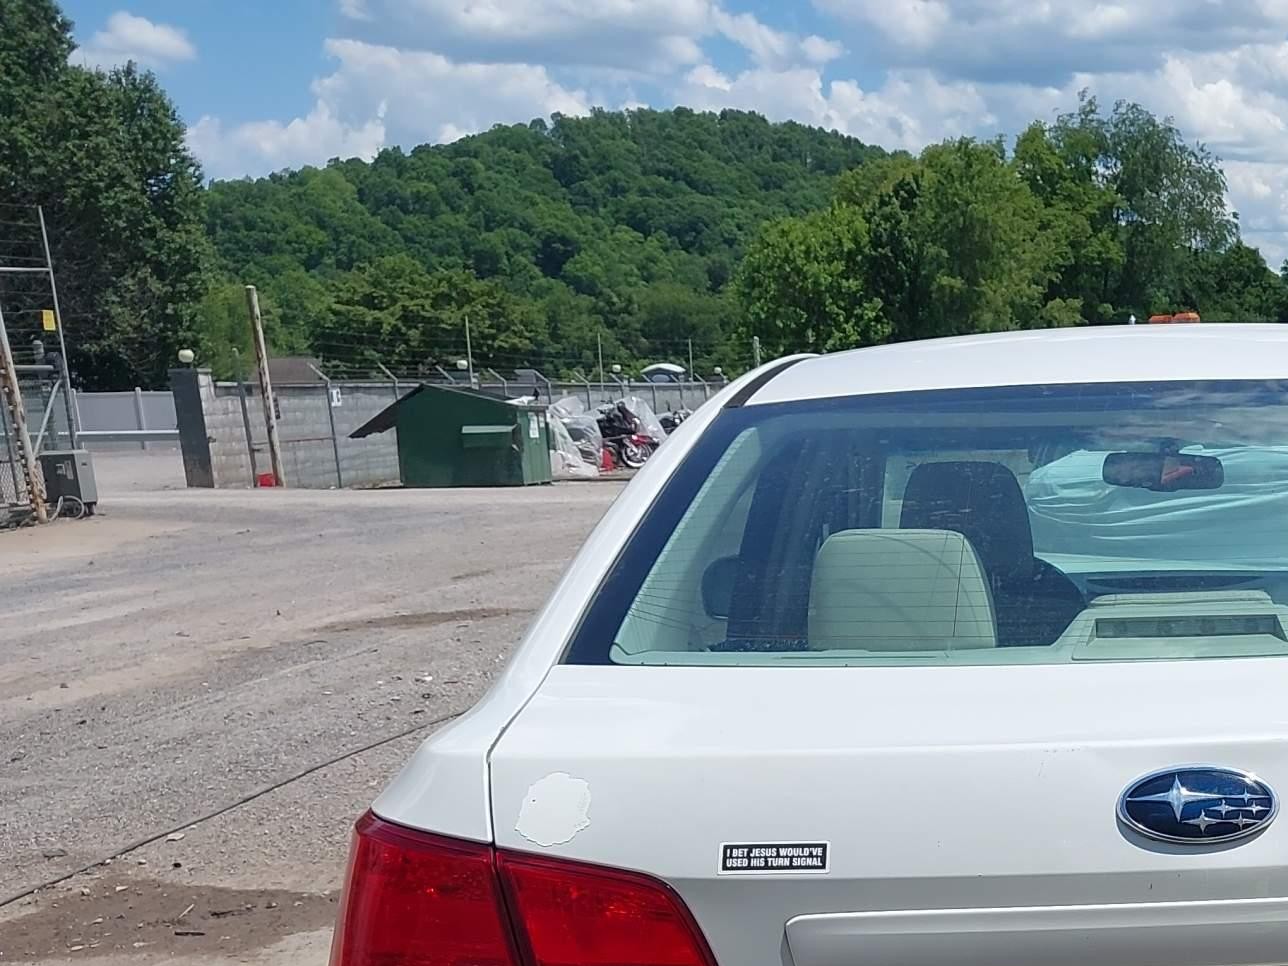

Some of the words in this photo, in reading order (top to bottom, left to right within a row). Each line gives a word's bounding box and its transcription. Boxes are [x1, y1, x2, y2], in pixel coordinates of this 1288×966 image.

[726, 848, 730, 857] I
[732, 848, 748, 857] BET
[750, 848, 776, 857] JESUS
[779, 848, 823, 856] WOULD'VE
[726, 858, 748, 867] USED
[750, 858, 765, 866] HIS
[767, 858, 790, 866] TURN
[792, 858, 823, 866] SIGNAL
